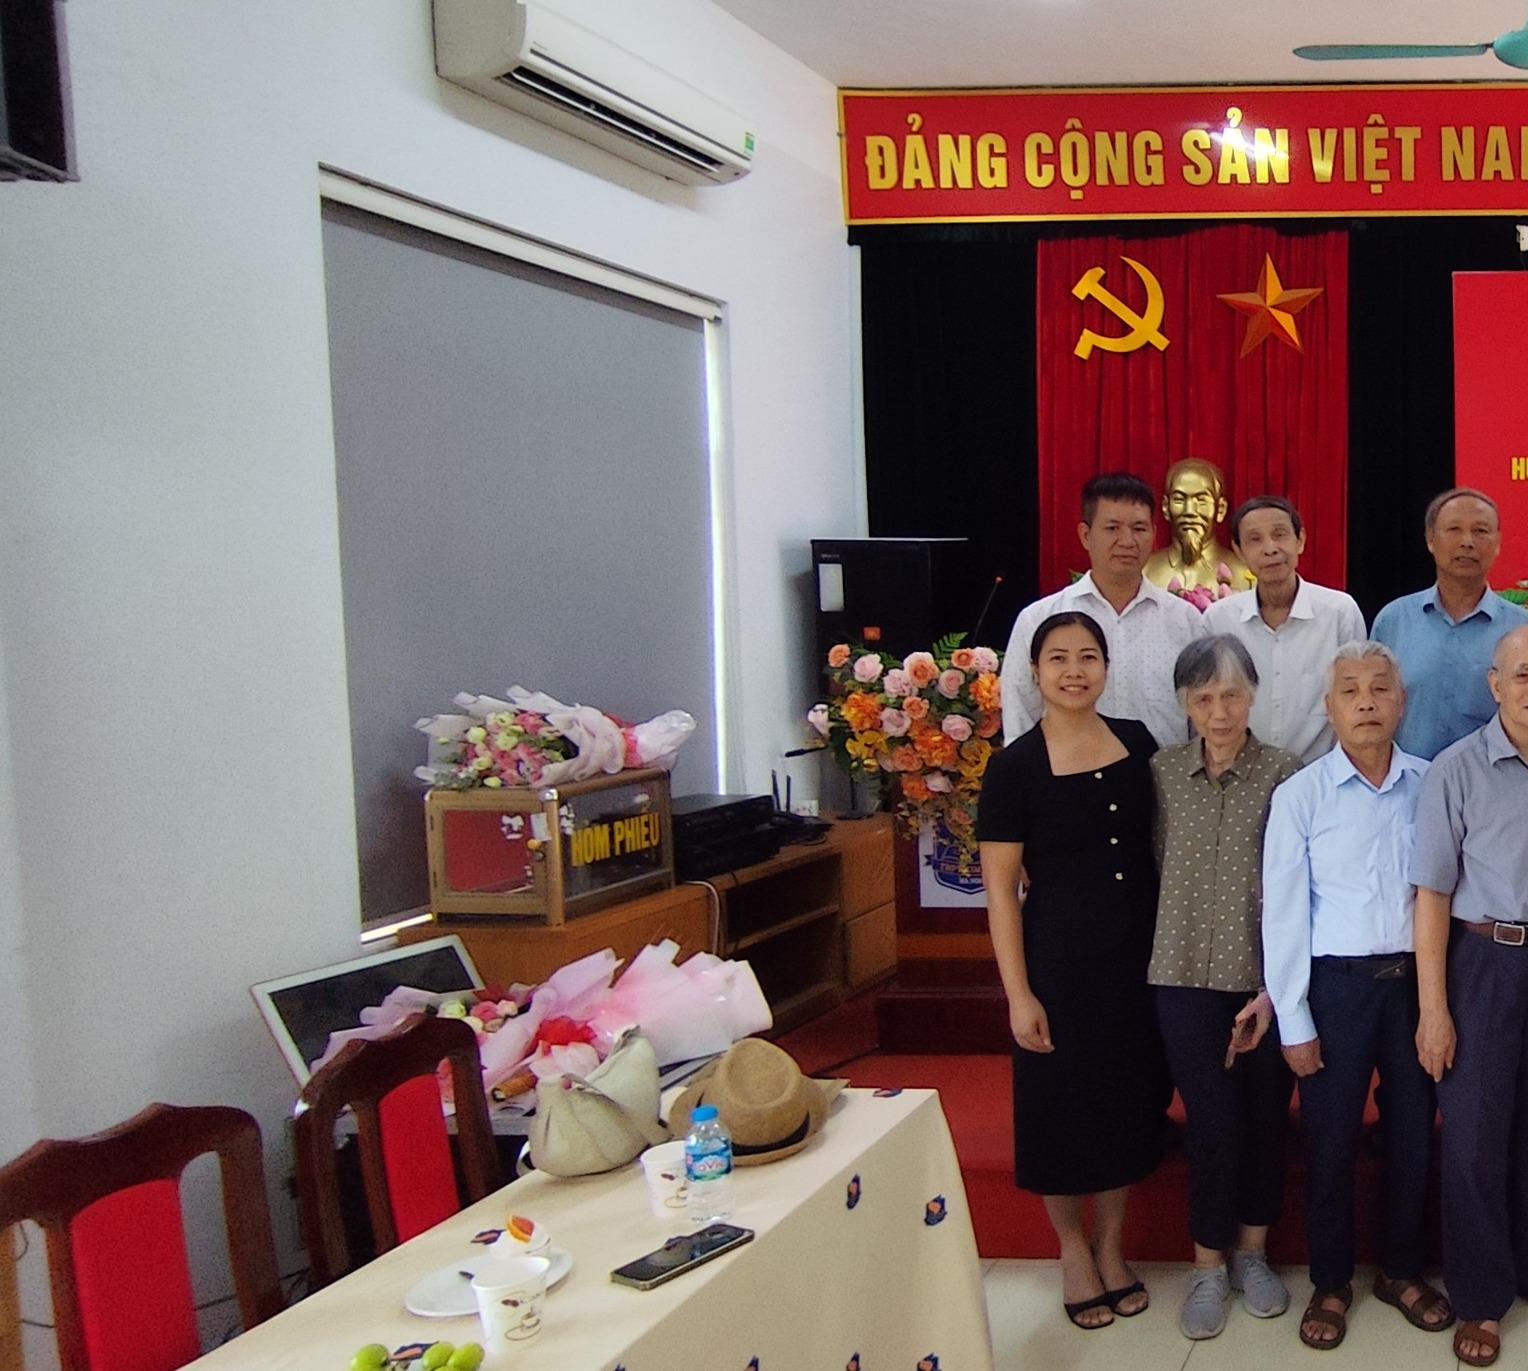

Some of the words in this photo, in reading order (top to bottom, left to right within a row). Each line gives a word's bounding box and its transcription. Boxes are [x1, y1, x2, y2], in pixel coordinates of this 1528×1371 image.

[865, 113, 1008, 190] ĐẢNG
[1024, 118, 1165, 200] CỘNG
[1181, 107, 1290, 185] SẢN
[1307, 113, 1422, 194] VIỆT
